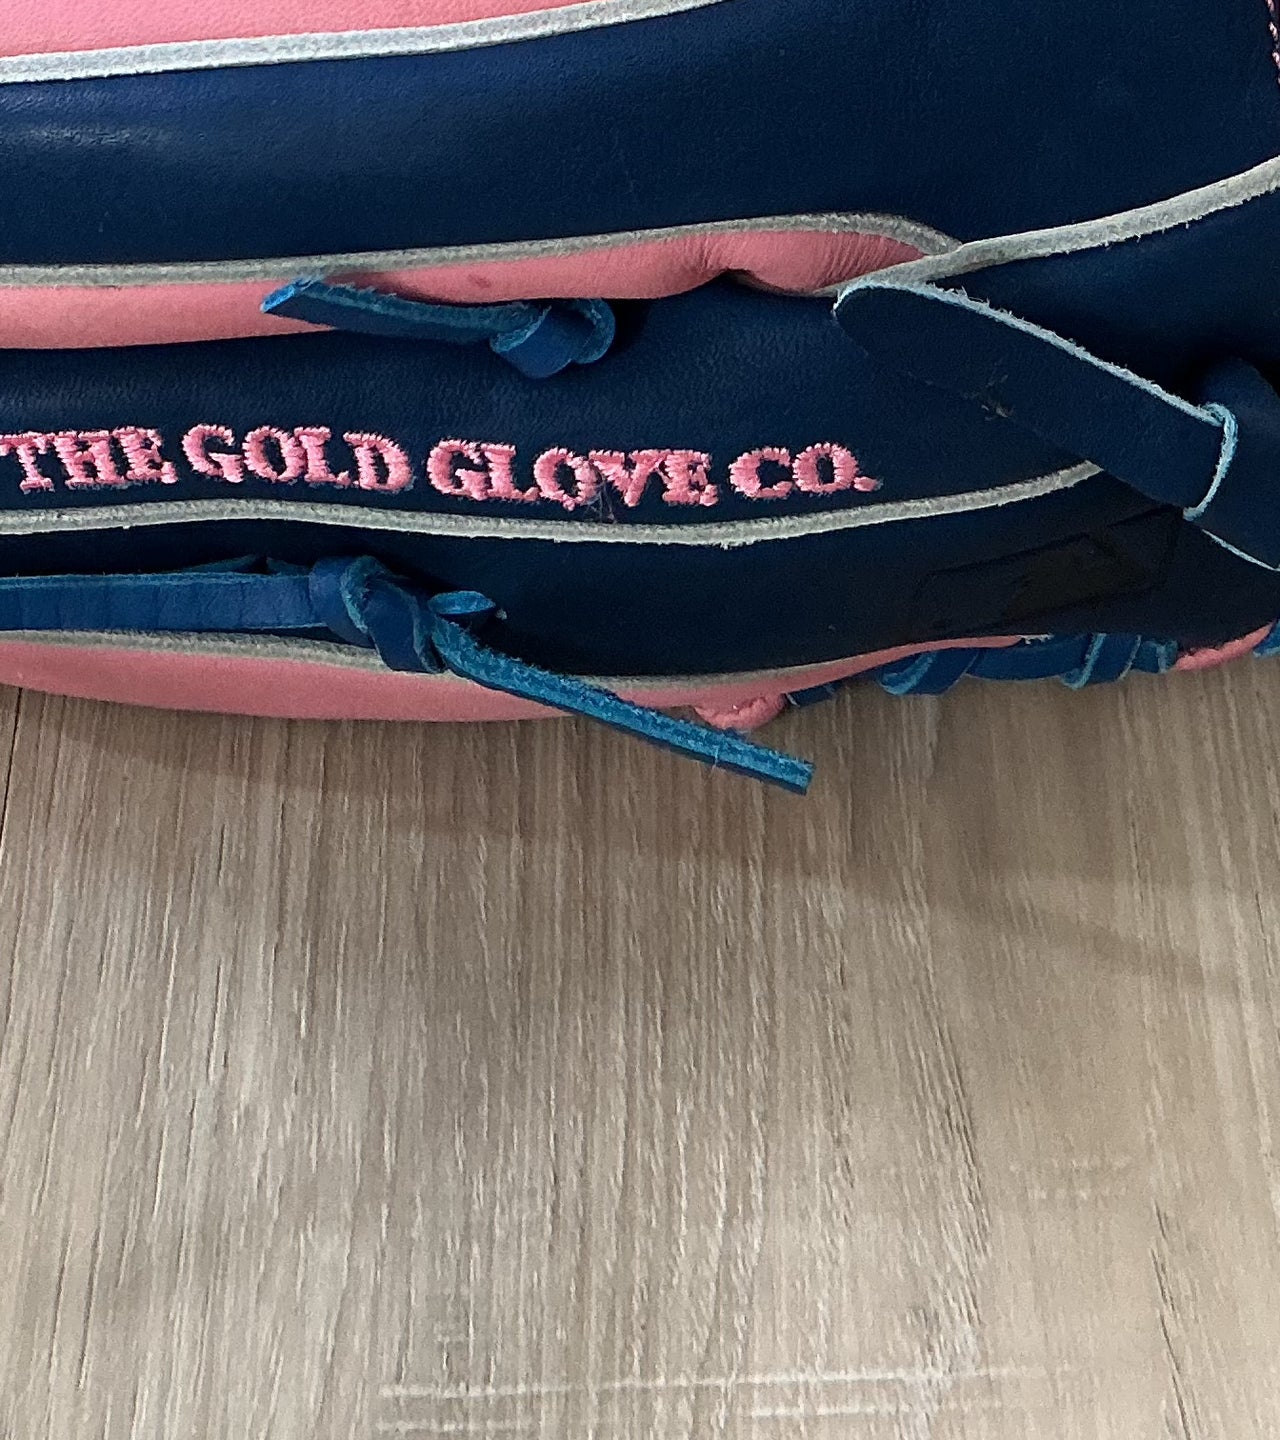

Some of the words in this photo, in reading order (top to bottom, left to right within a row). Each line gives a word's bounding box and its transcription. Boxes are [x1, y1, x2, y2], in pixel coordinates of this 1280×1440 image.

[181, 424, 414, 492] GOLD
[426, 438, 719, 511] GLOVE
[729, 442, 882, 500] CO.
